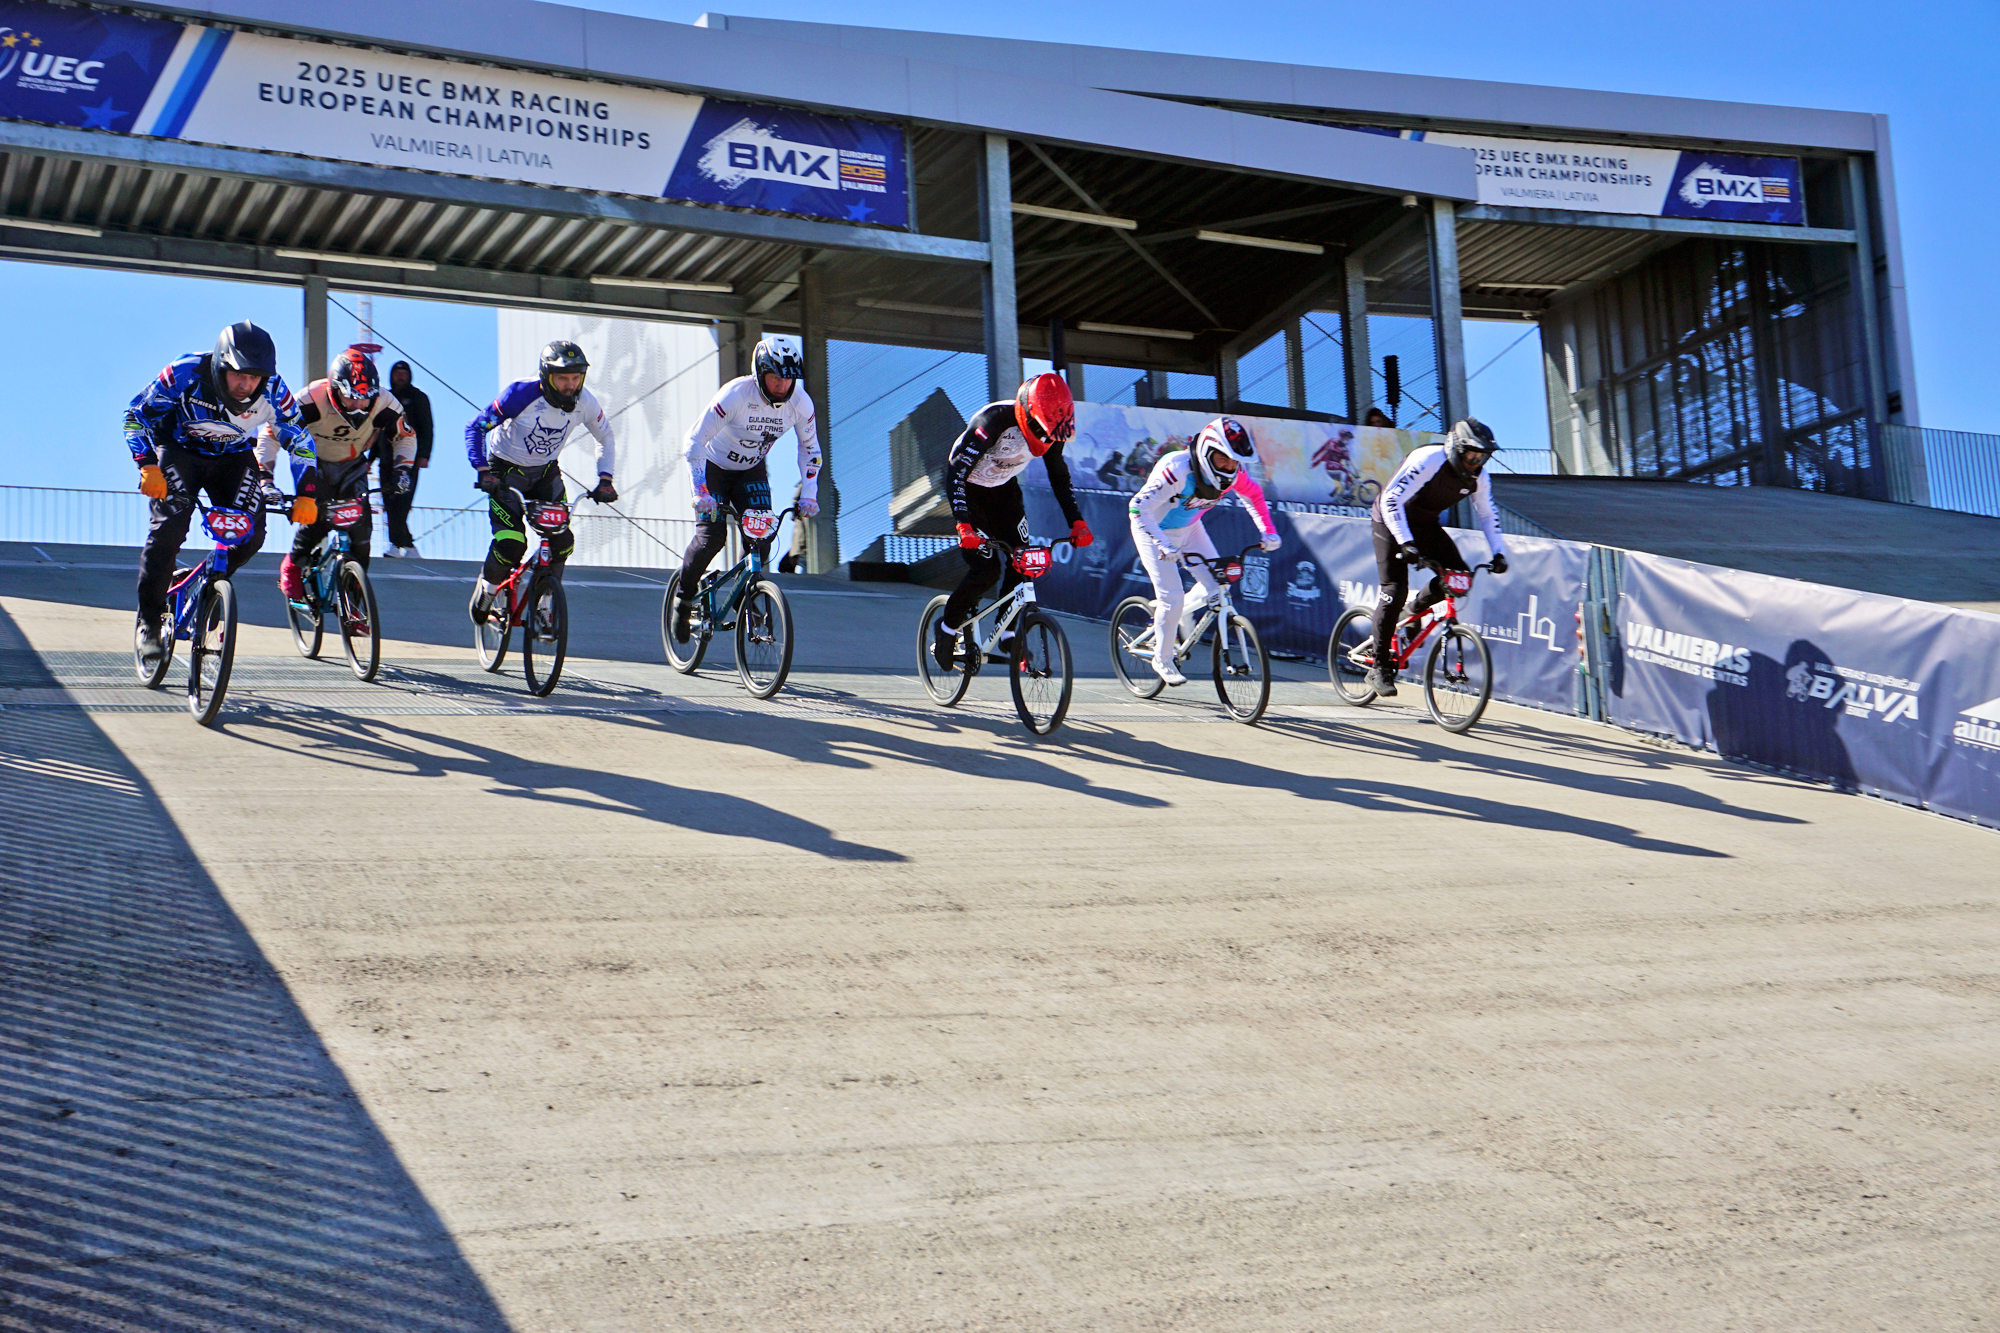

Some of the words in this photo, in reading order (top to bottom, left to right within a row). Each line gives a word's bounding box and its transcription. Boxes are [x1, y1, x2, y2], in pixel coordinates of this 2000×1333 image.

[21, 51, 105, 84] UEC
[297, 62, 366, 88] 2025
[377, 72, 432, 97] UEC
[442, 81, 501, 106] BMX
[511, 90, 609, 120] RACING
[258, 82, 414, 120] EUROPEAN
[426, 105, 650, 150] CHAMPIONSHIPS
[370, 133, 473, 160] VALMIERA
[487, 147, 553, 169] LATVIA
[839, 149, 886, 162] EUROPEAN
[1501, 150, 1531, 164] UEC
[1536, 152, 1568, 166] BMX
[1573, 155, 1628, 170] RACING
[728, 142, 832, 181] BMX
[839, 163, 886, 179] 2025
[1475, 164, 1523, 178] OPEAN
[1528, 167, 1652, 187] CHAMPIONSHIPS
[841, 180, 887, 193] VALMIERA
[1501, 187, 1555, 200] VALMIERA
[1563, 191, 1599, 202] LATVIA
[1696, 178, 1758, 198] BMX
[189, 397, 217, 411] VALMIERA
[746, 424, 762, 432] VELO
[764, 425, 783, 433] FANS
[748, 416, 783, 425] GULBENES
[211, 517, 248, 530] 456
[748, 517, 767, 530] 585
[1025, 552, 1046, 565] 346
[1627, 621, 1752, 674] VALMIERAS
[1702, 666, 1749, 687] CENTRS
[1808, 675, 1919, 723] BALVA
